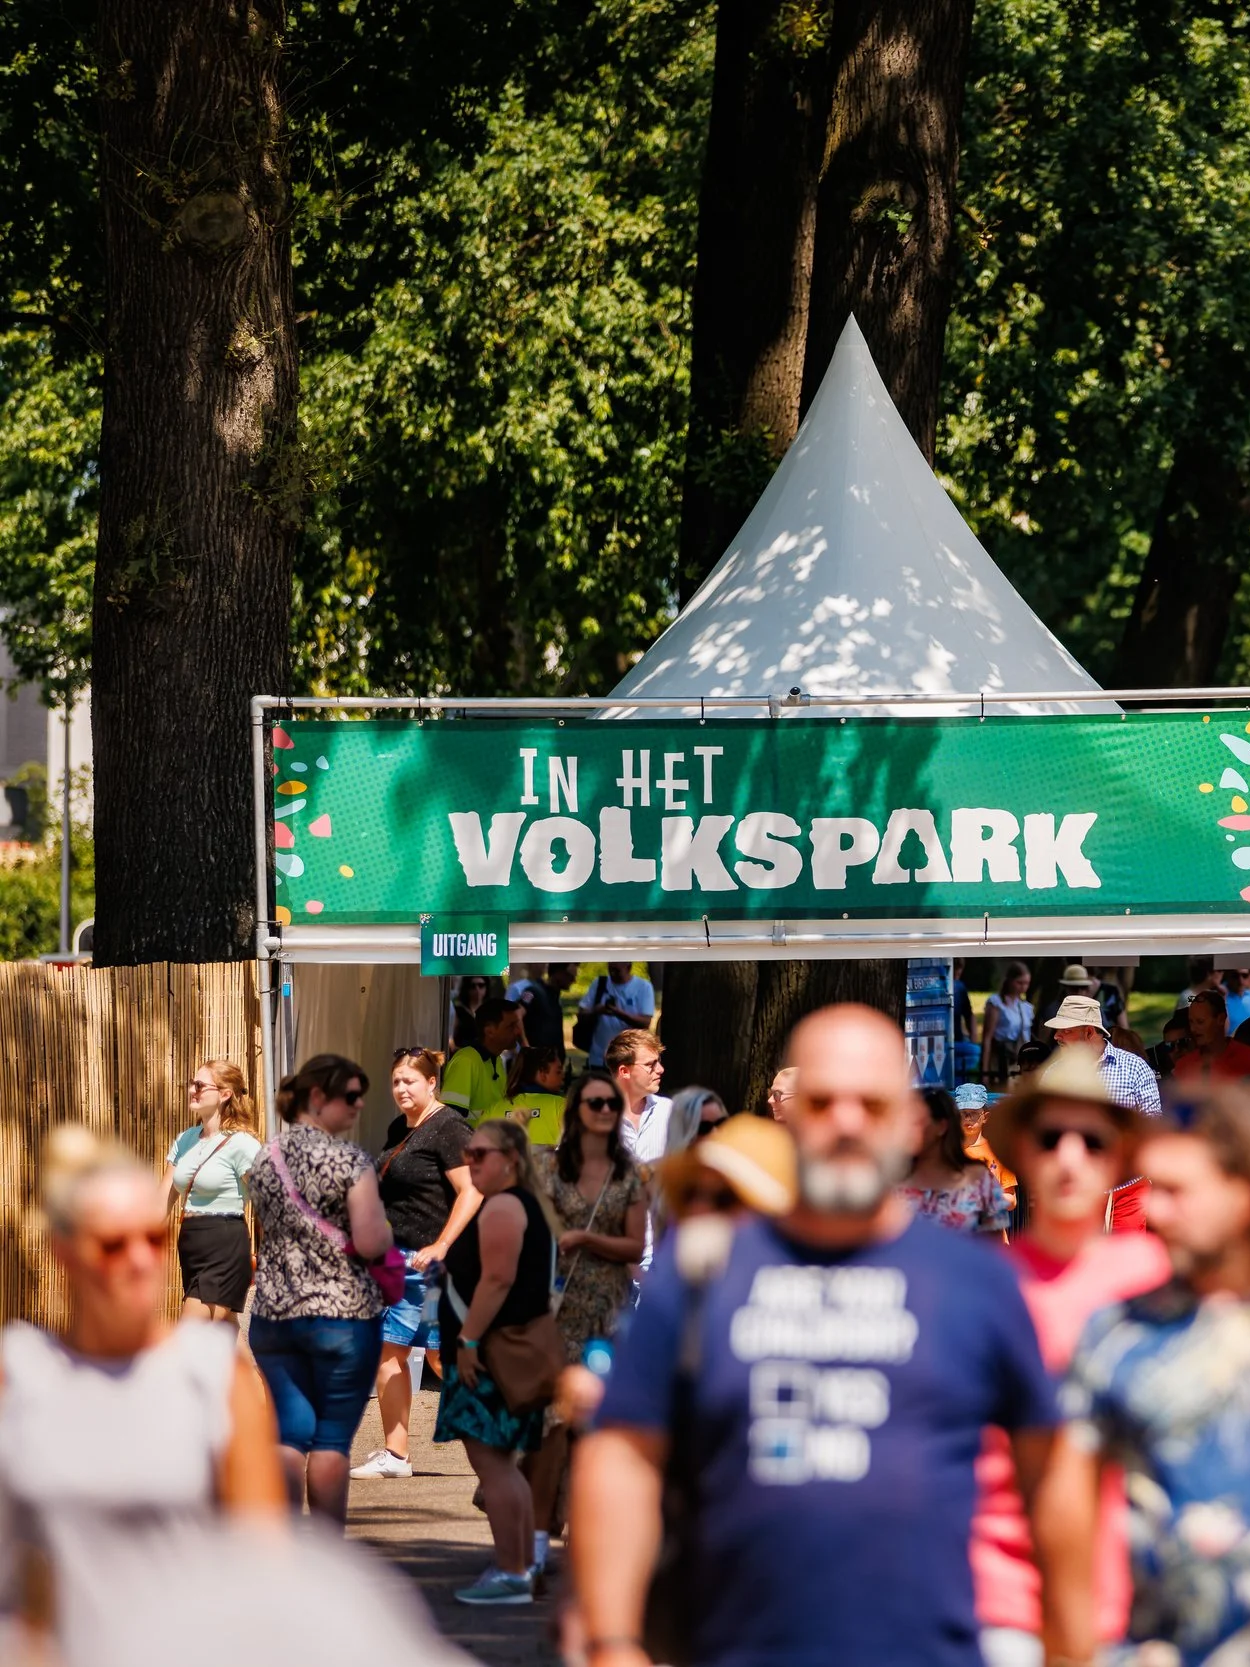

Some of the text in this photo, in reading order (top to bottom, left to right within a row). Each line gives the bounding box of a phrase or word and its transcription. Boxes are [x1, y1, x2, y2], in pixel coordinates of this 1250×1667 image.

[520, 745, 723, 813] IN HET
[448, 806, 1101, 893] VOLKSPARK
[433, 933, 497, 957] UITGANG
